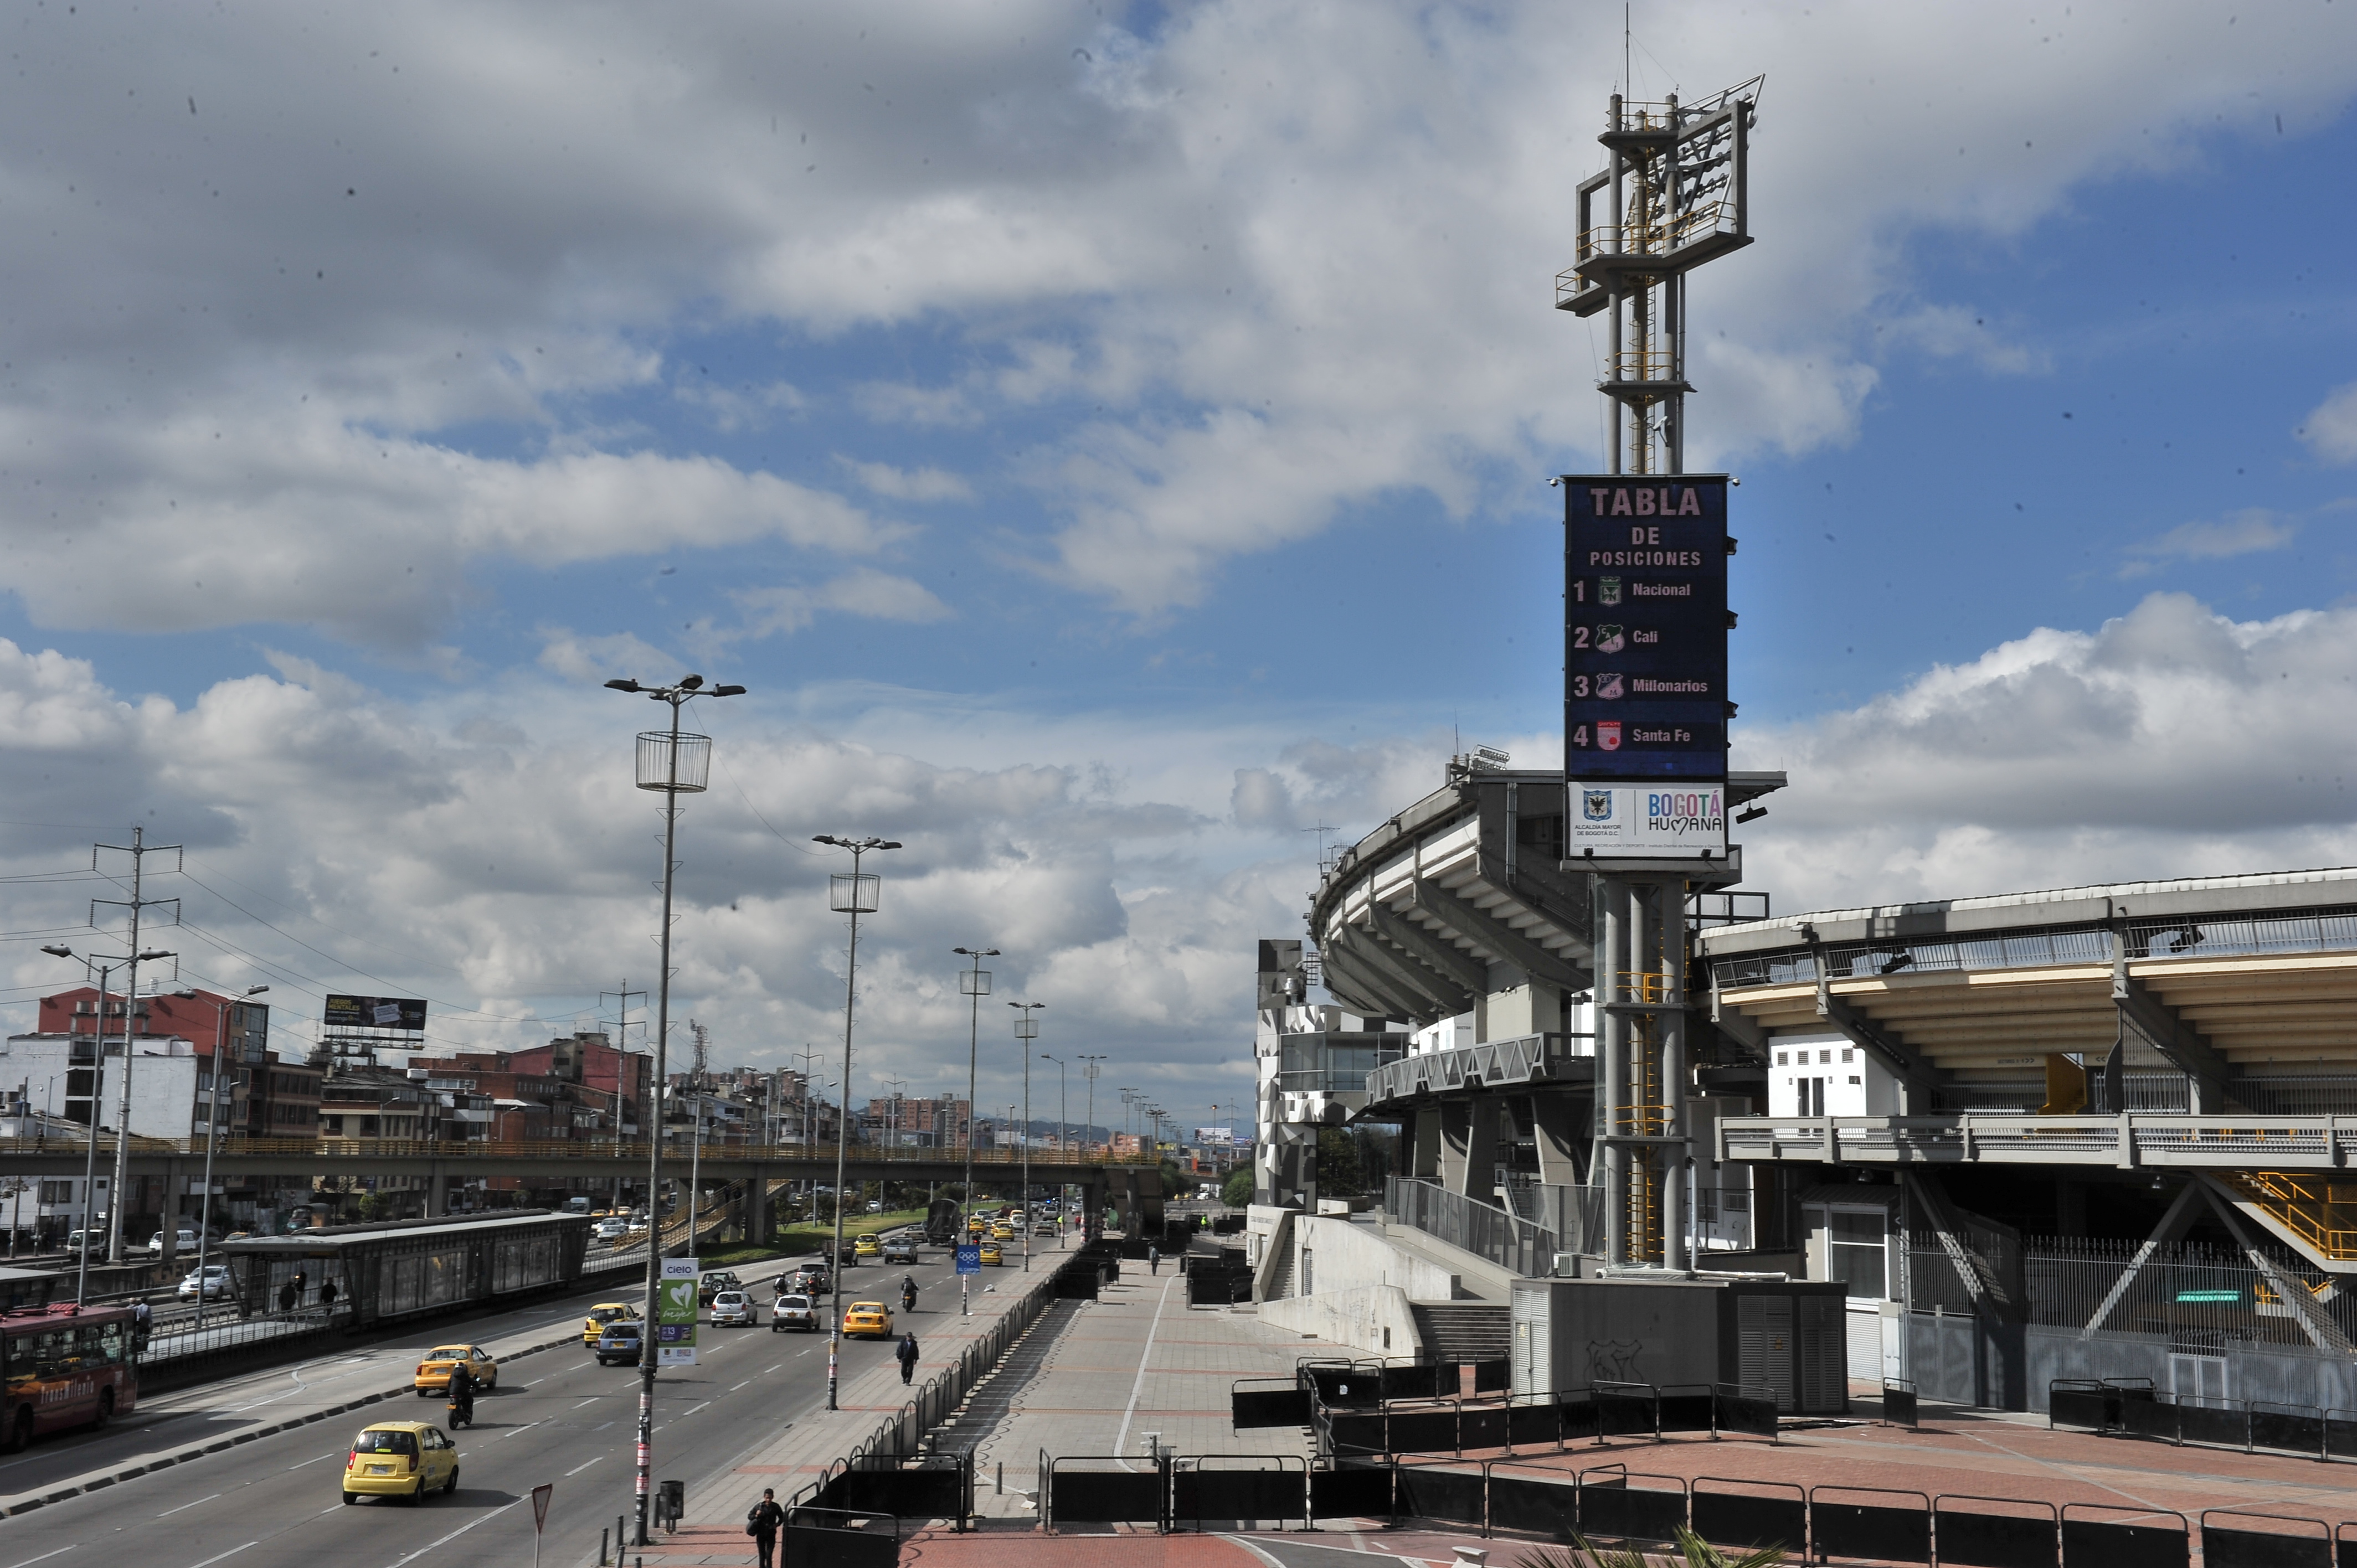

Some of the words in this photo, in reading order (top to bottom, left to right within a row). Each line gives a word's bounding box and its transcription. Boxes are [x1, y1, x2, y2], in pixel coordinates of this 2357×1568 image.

[1590, 487, 1701, 516] TABLA
[1632, 527, 1660, 545] DE
[1590, 551, 1701, 566] POSICIONES
[1573, 580, 1584, 602] 1
[1633, 583, 1691, 596] Nacional
[1574, 627, 1589, 648] 2
[1633, 630, 1658, 643] Cali
[1574, 675, 1589, 697] 3
[1633, 679, 1707, 692] Millonarios
[1573, 725, 1588, 747] 4
[1633, 729, 1671, 742] Santa
[1675, 729, 1691, 742] Fe
[1649, 790, 1721, 817] BOGOTÁ
[1649, 817, 1722, 835] HUMANA
